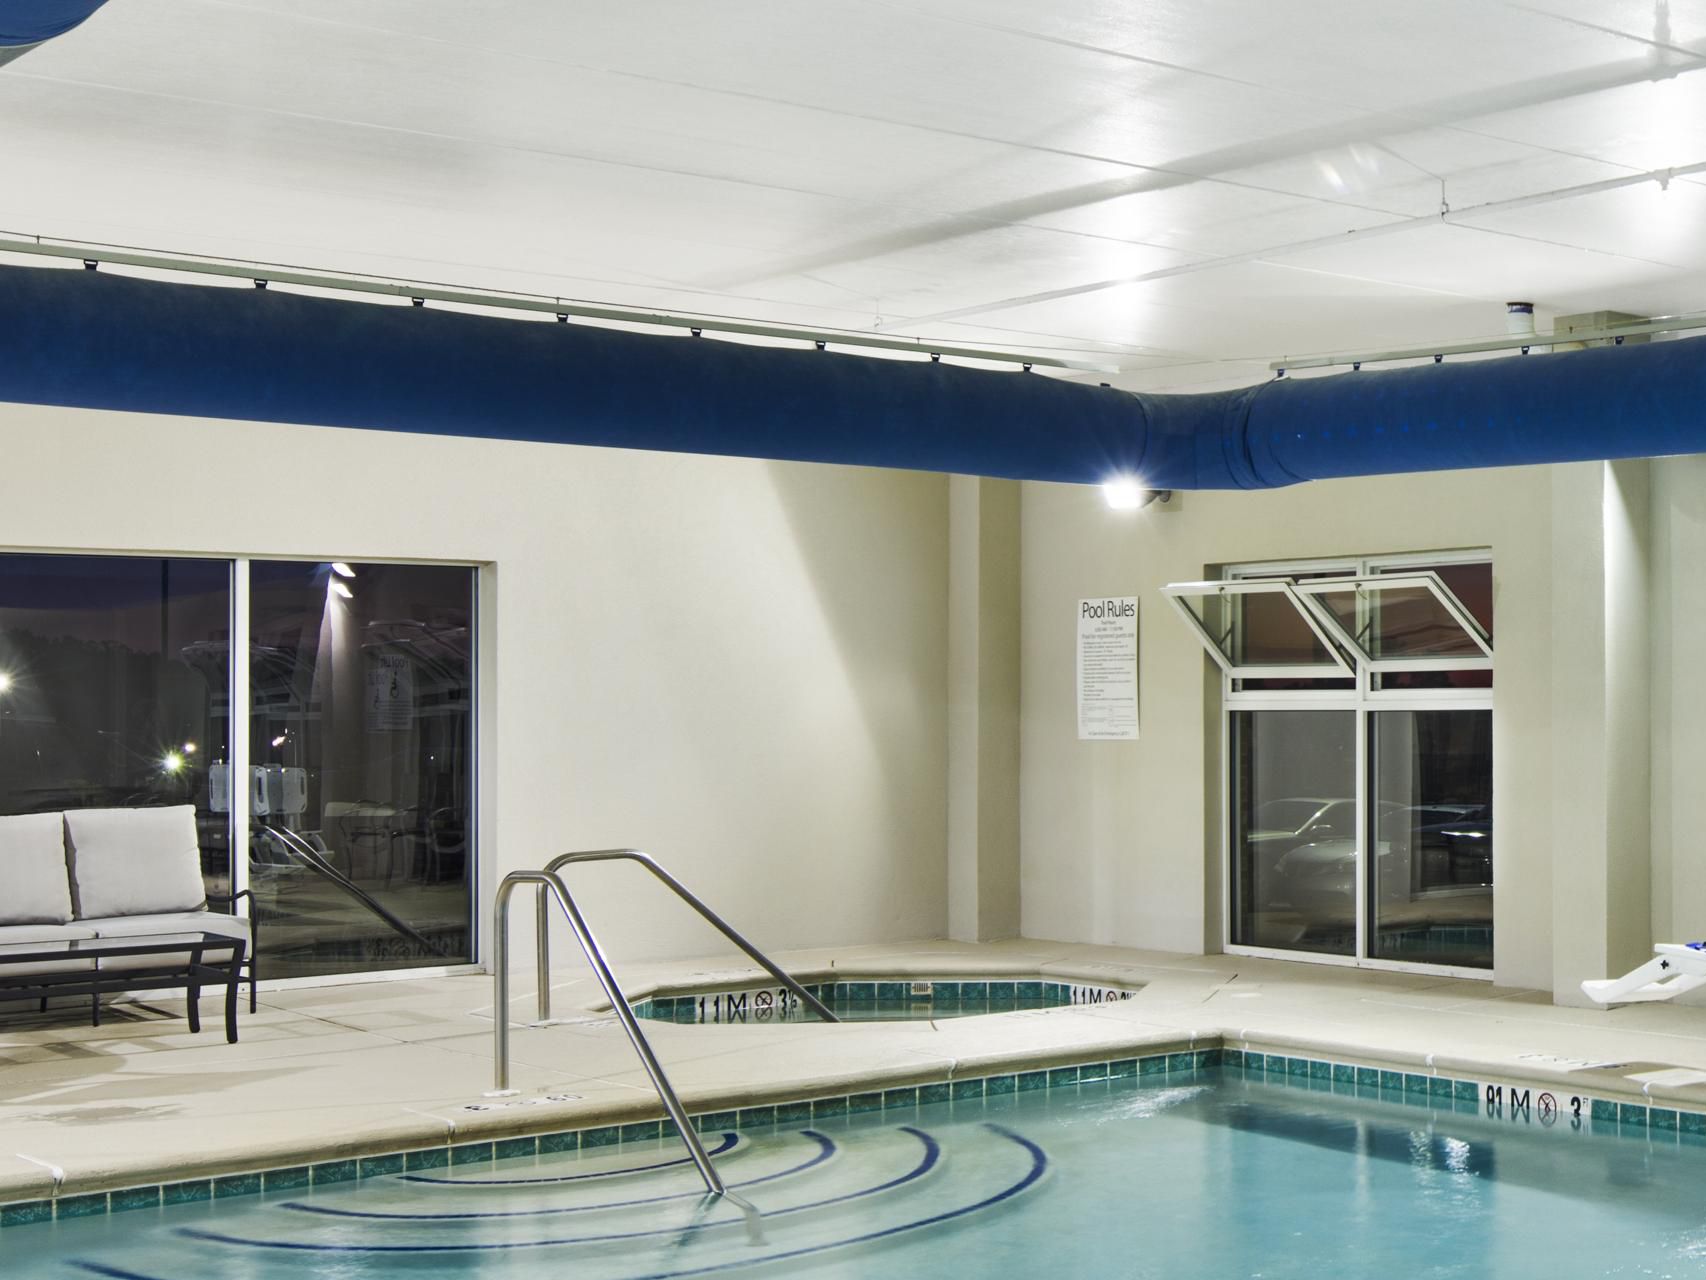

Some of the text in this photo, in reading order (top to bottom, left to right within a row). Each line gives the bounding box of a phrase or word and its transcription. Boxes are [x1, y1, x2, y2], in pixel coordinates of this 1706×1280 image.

[1082, 600, 1135, 619] Pool Rules
[727, 993, 747, 1010] M
[1089, 988, 1102, 1004] M
[1511, 1087, 1530, 1110] M
[1570, 1096, 1581, 1118] 3
